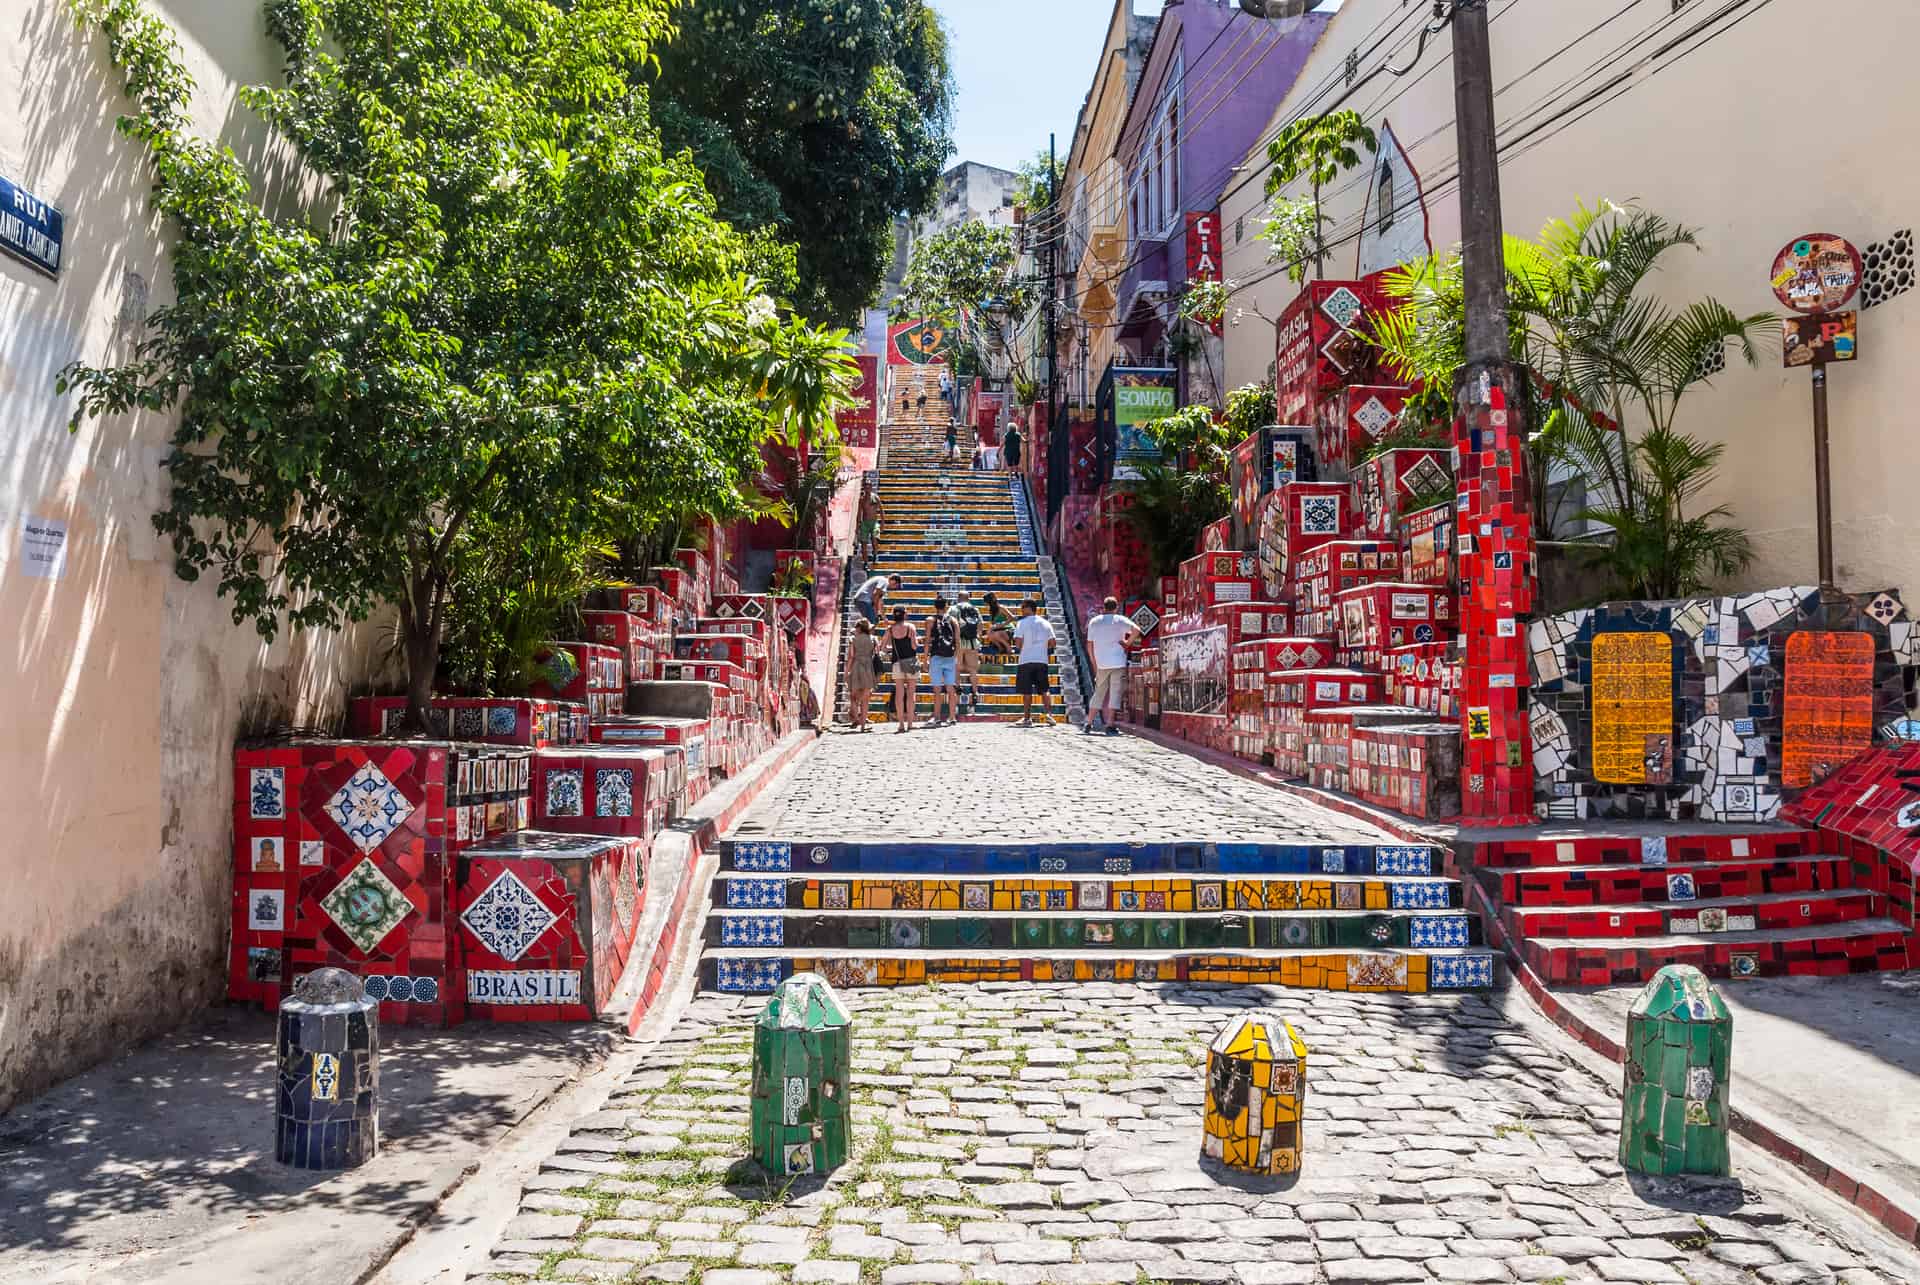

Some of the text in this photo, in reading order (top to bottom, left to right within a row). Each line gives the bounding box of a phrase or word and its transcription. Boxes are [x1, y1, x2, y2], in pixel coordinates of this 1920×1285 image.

[13, 189, 48, 226] RUA
[0, 210, 24, 248] ANUEL
[1279, 310, 1309, 354] BRASIL
[1118, 390, 1174, 407] SONHO
[476, 976, 572, 998] BRASIL
